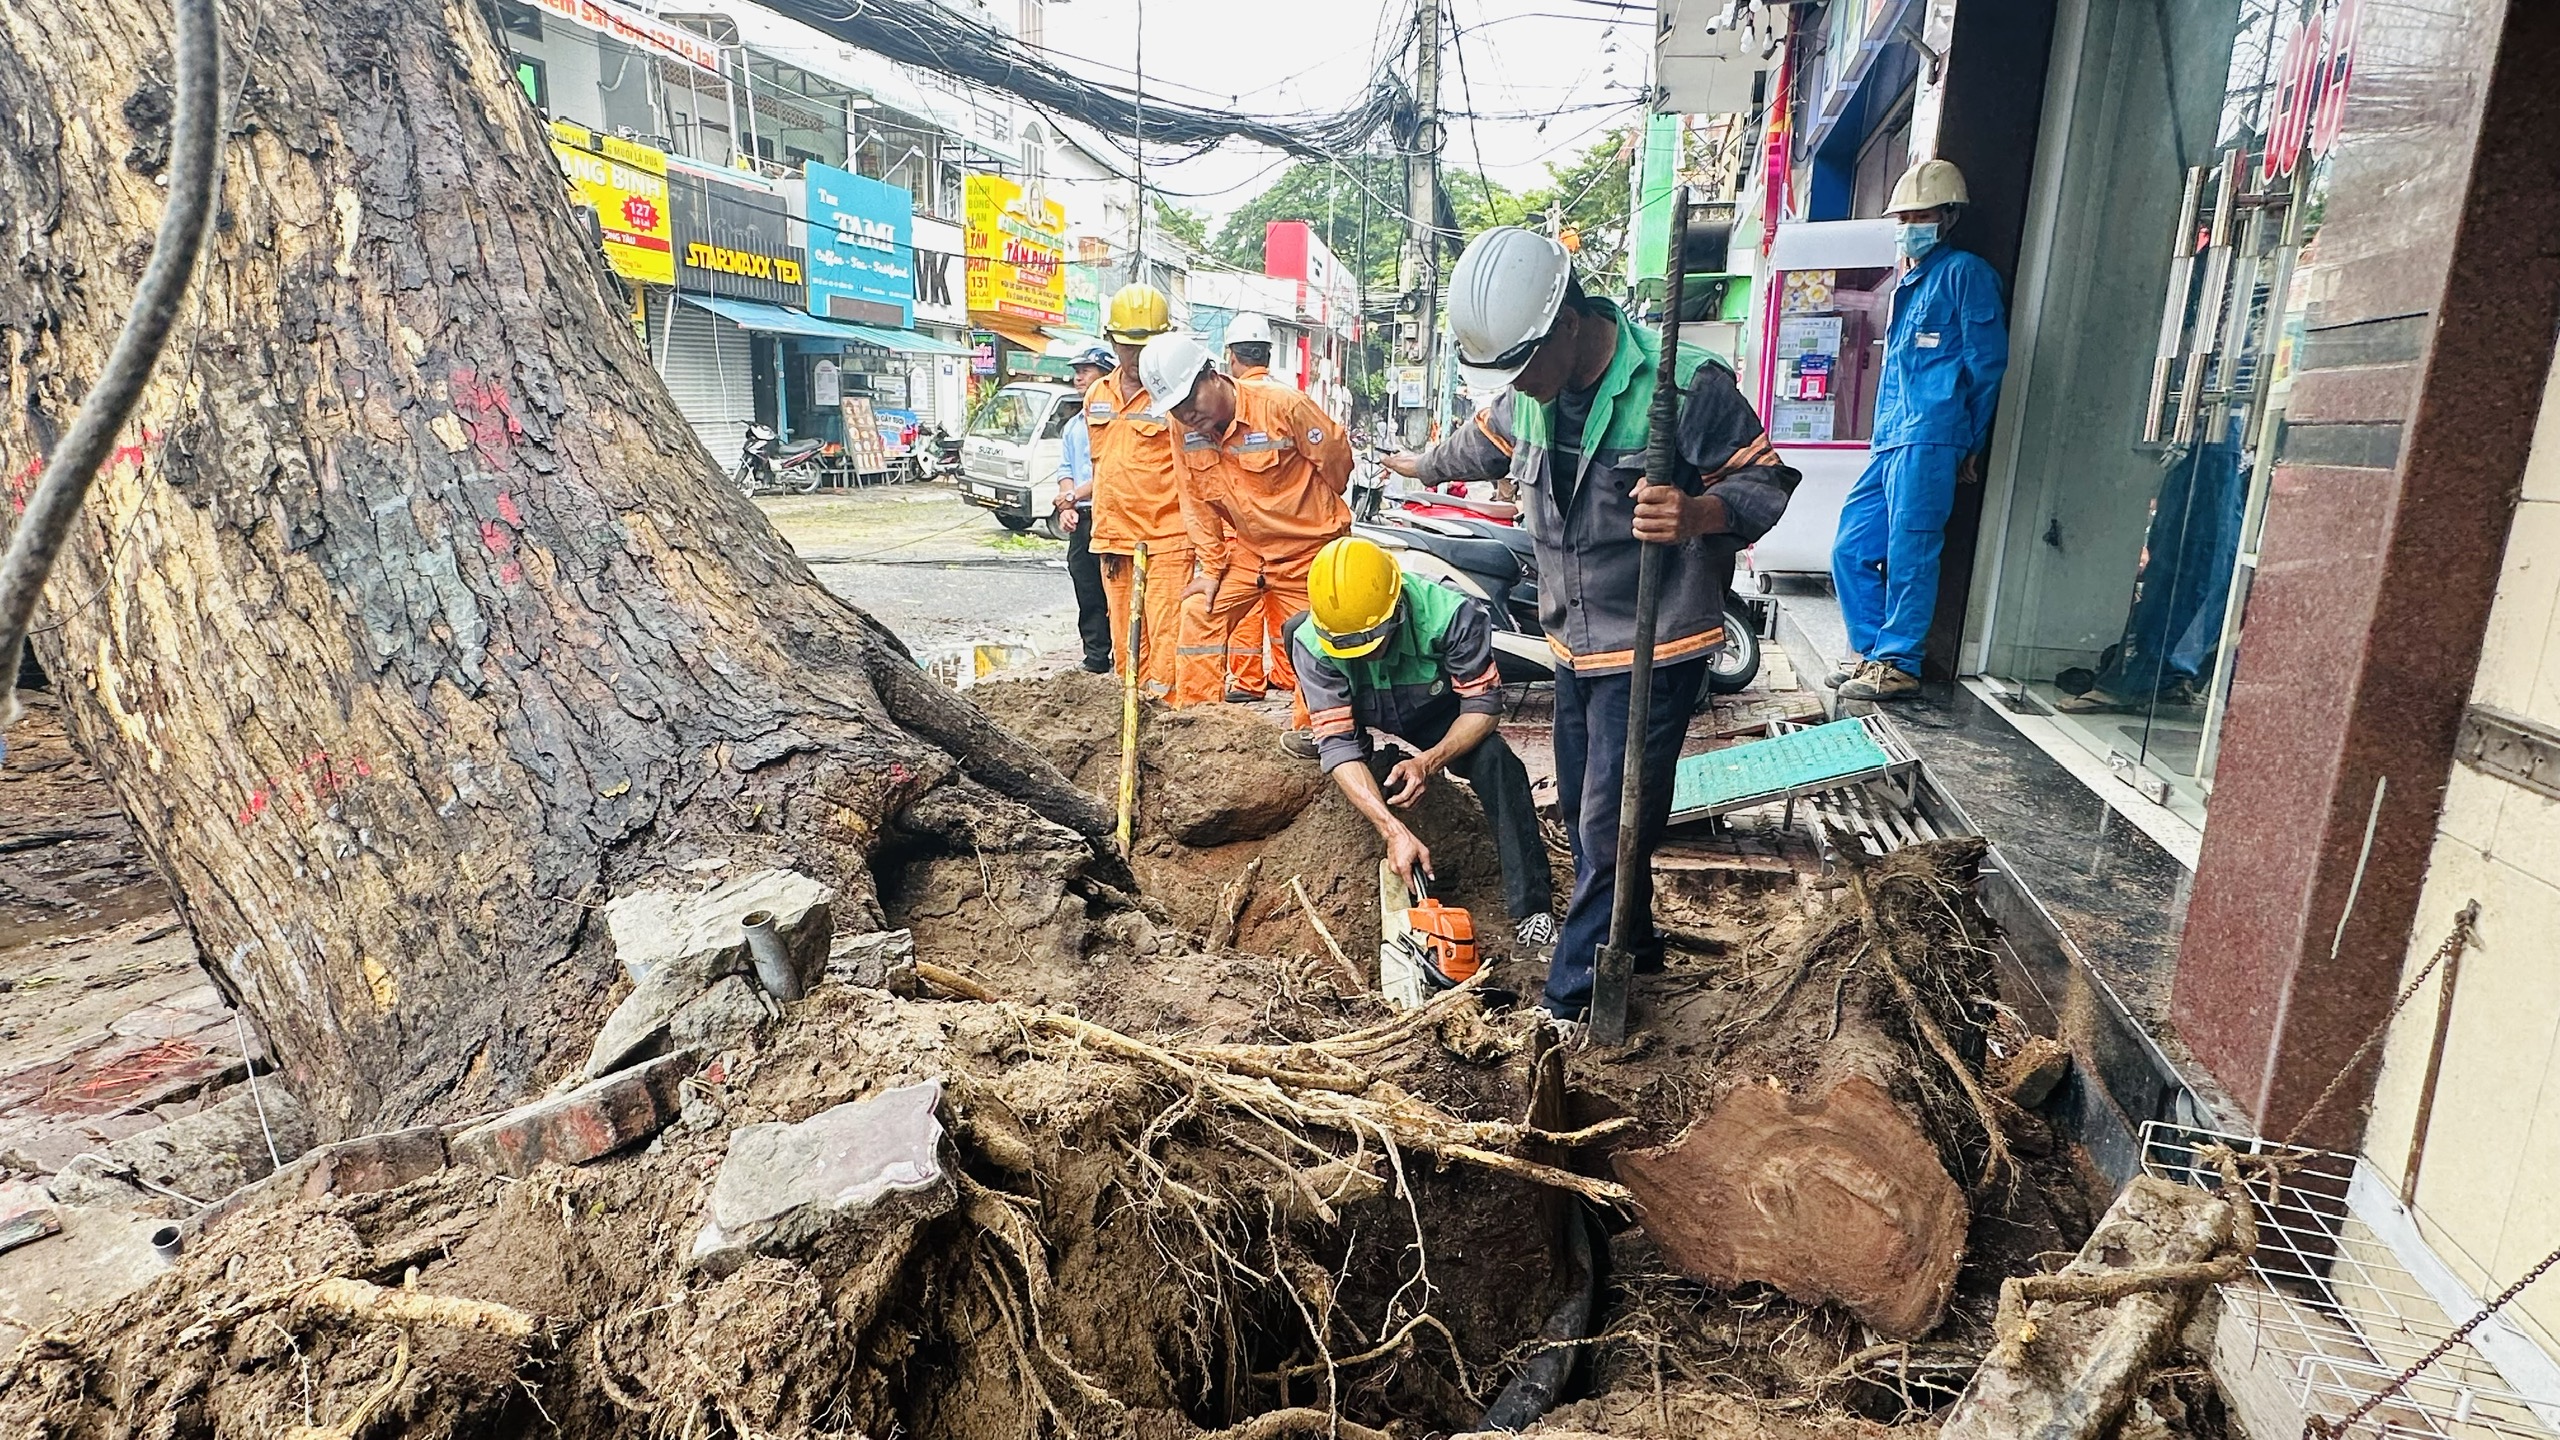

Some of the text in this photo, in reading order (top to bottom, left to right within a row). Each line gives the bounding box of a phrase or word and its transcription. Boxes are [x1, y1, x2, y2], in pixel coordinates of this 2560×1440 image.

[629, 202, 650, 217] 127
[833, 211, 896, 254] TAMI
[685, 242, 803, 286] STARMAXX TEA
[815, 249, 845, 267] Coffee
[971, 276, 988, 288] 131
[978, 445, 1004, 457] SUZUKI
